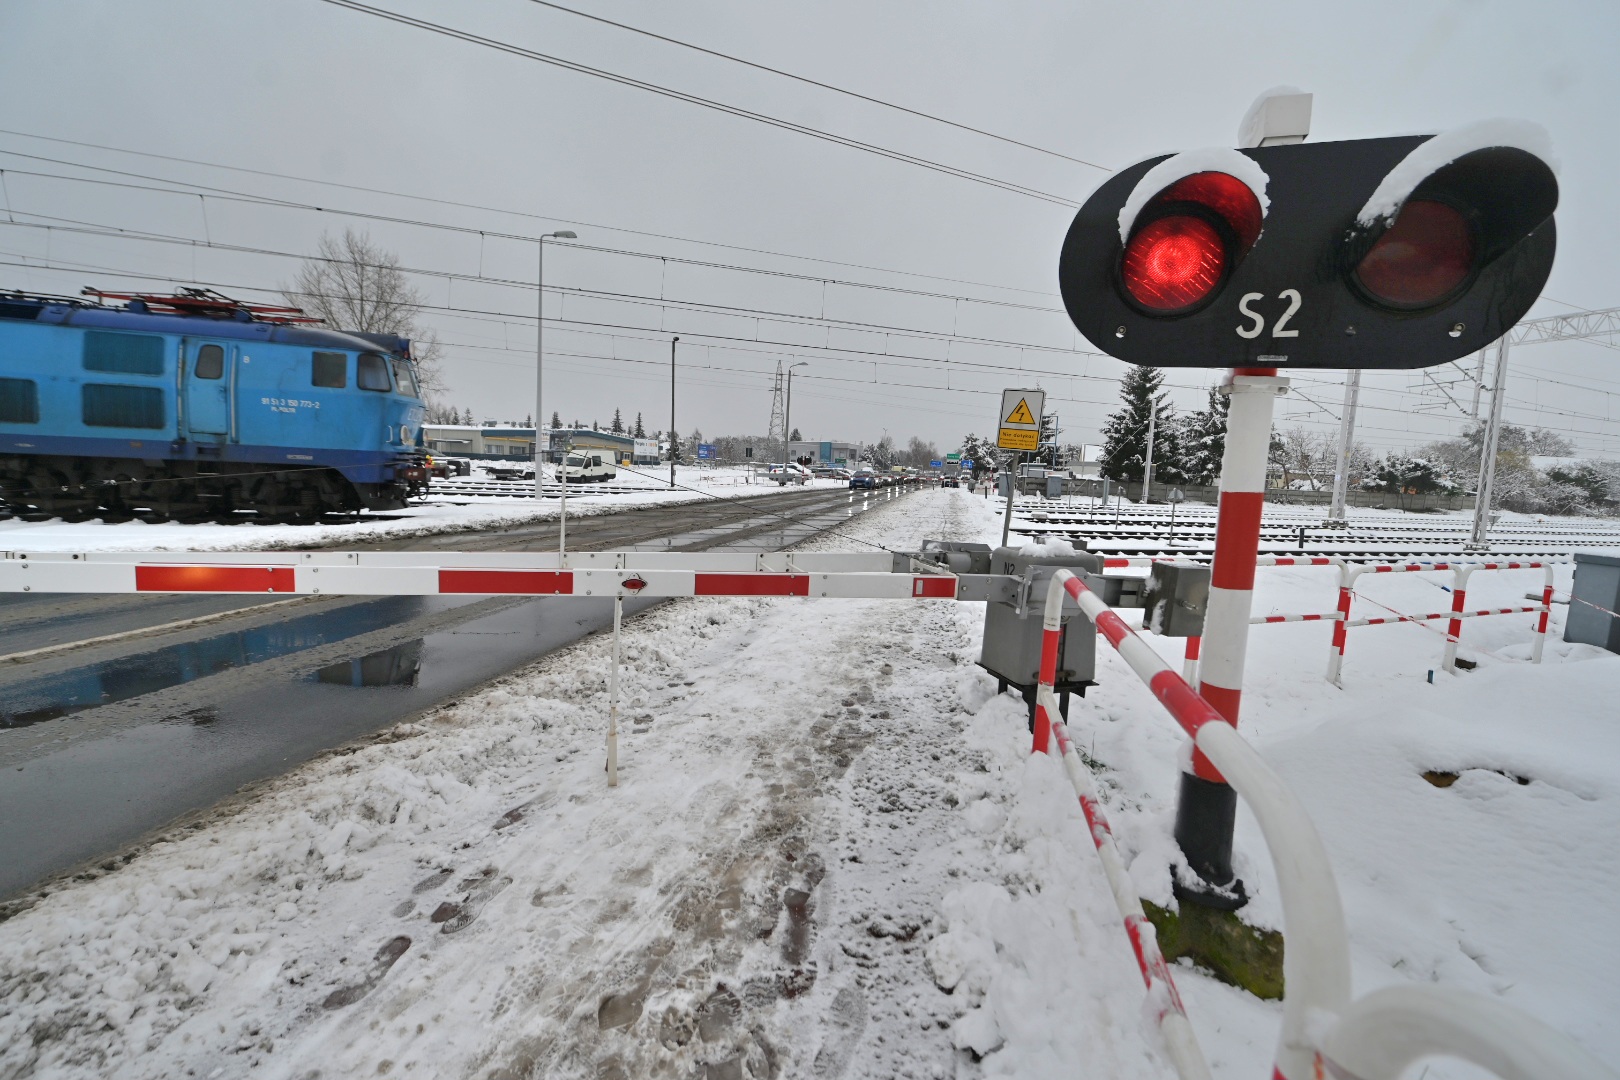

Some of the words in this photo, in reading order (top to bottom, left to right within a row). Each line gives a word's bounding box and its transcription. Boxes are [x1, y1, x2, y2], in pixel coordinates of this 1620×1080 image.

[1235, 287, 1302, 339] S2
[280, 398, 286, 406] 3
[300, 400, 320, 409] 773-2
[1003, 561, 1016, 575] N2
